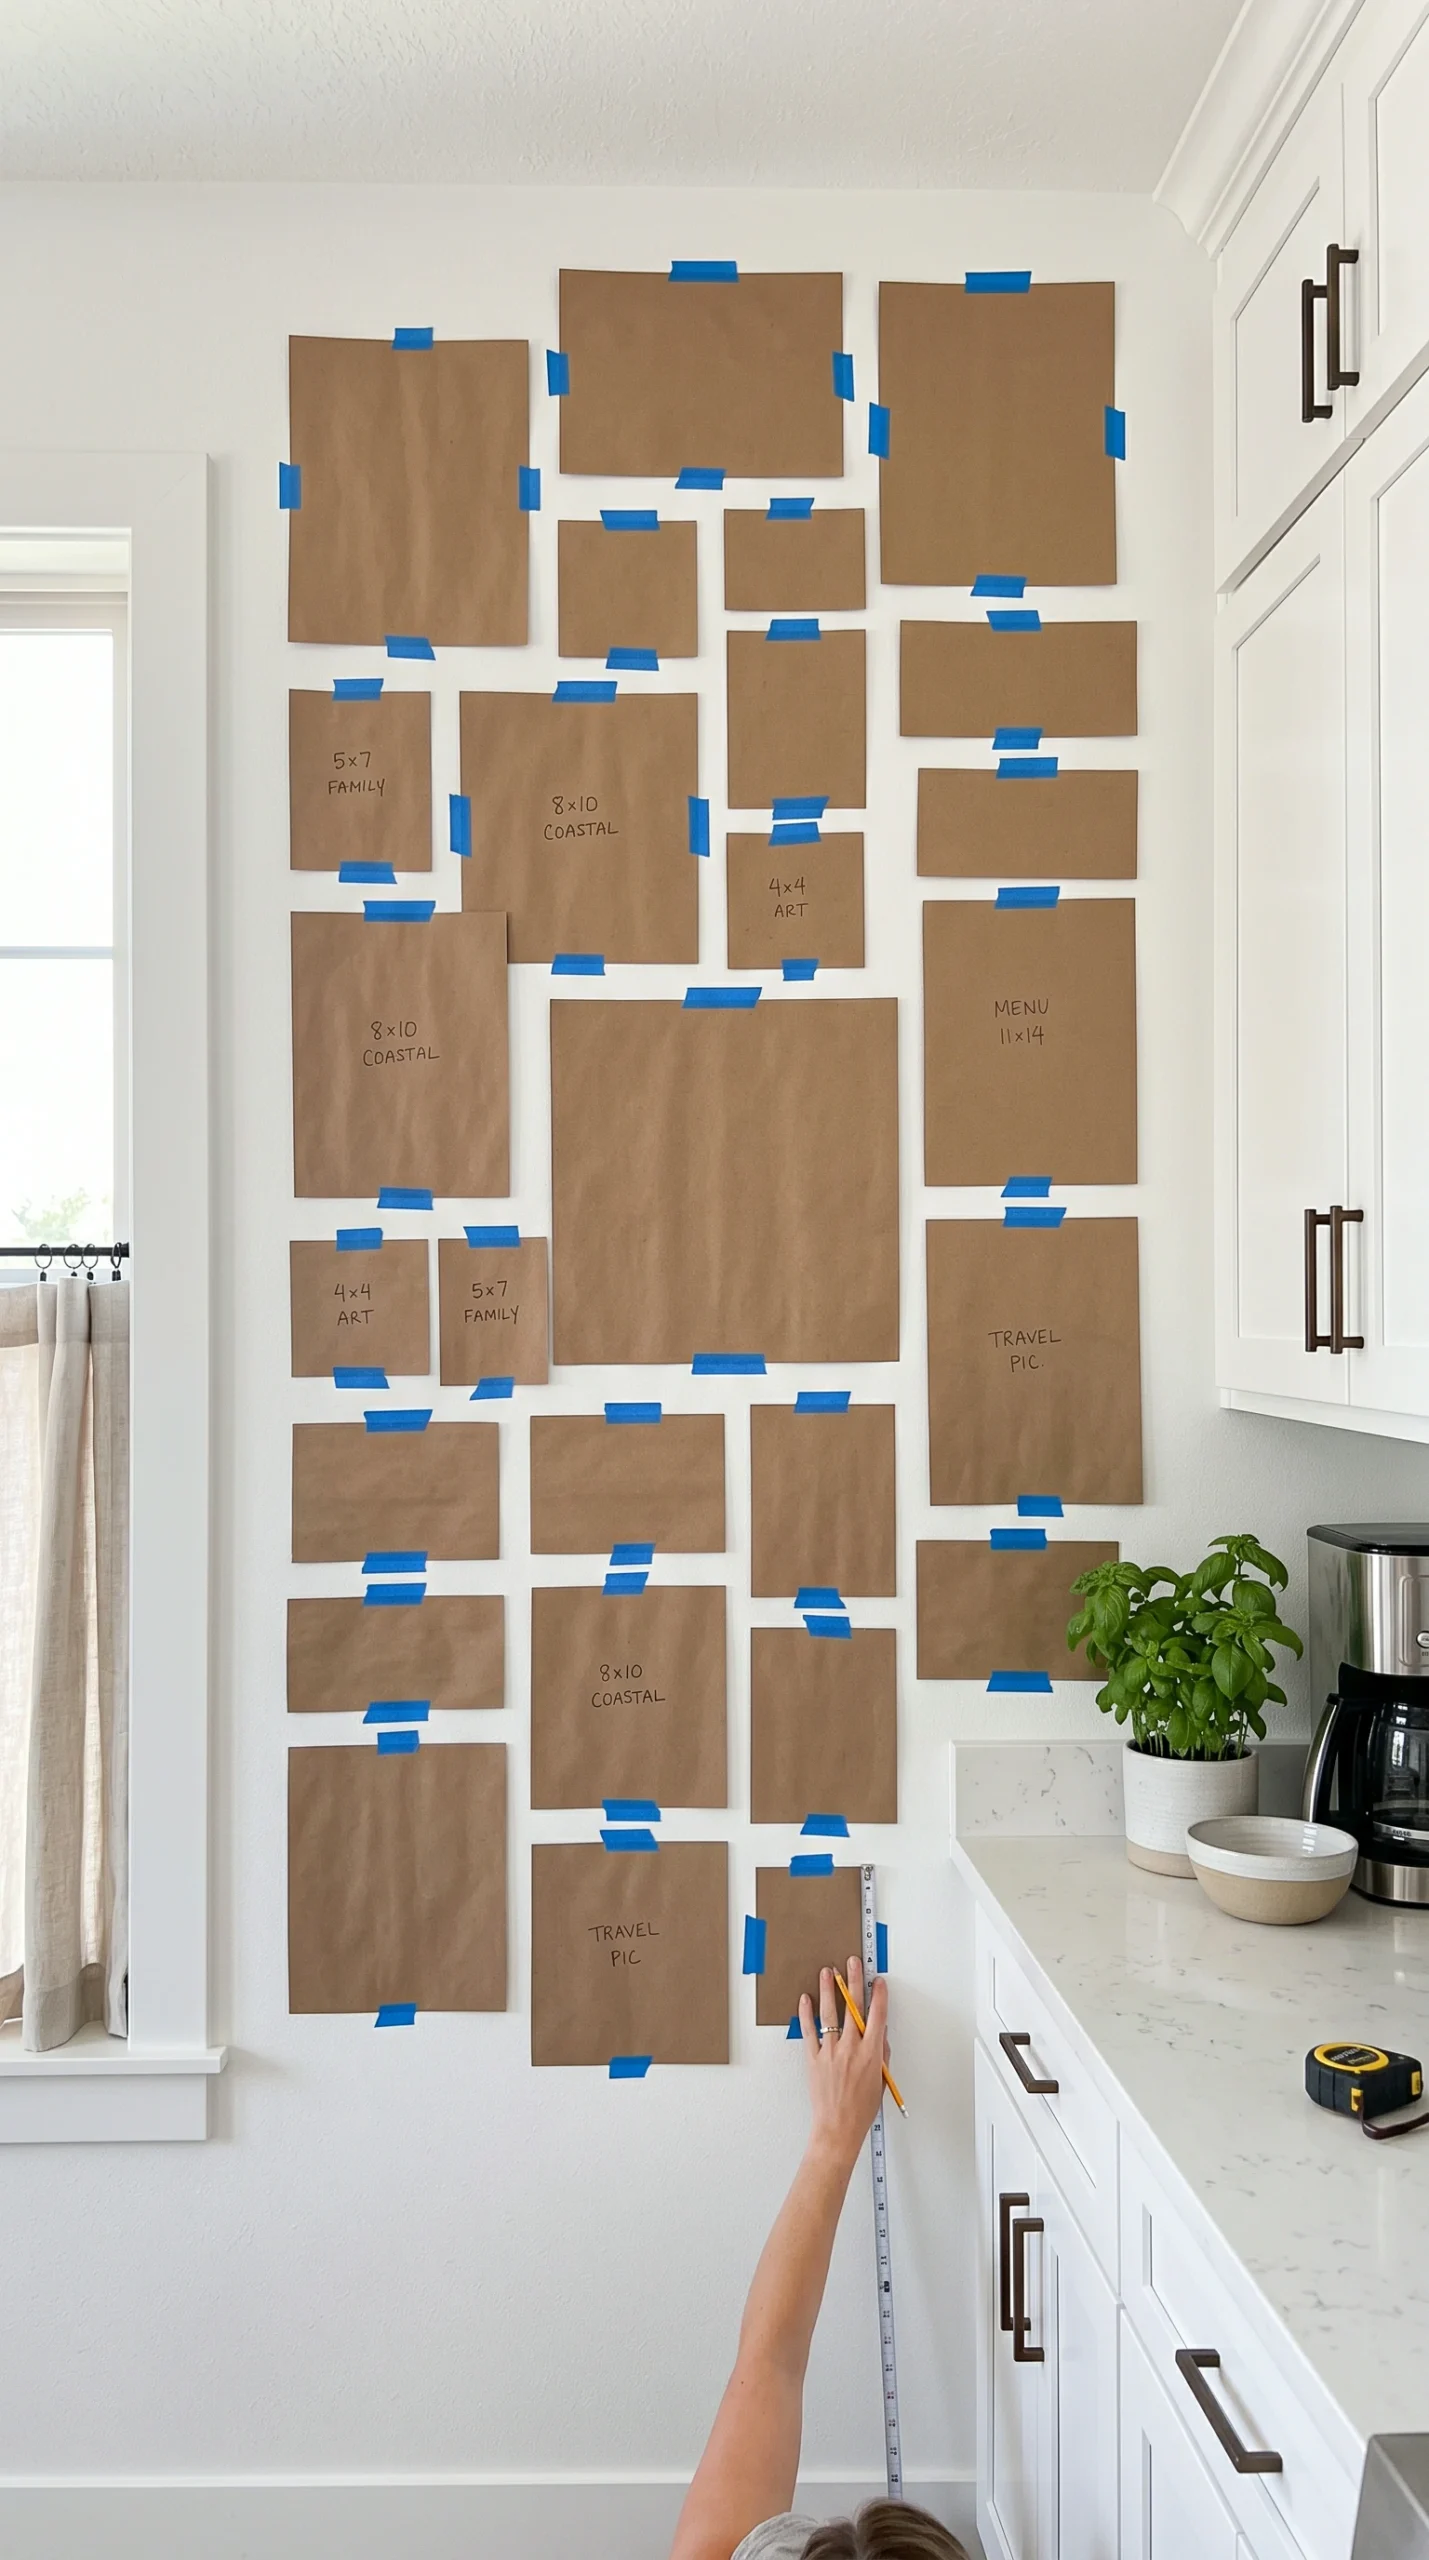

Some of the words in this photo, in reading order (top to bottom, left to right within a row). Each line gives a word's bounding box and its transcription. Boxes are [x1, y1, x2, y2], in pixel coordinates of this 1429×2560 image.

[331, 750, 371, 771] 5x7
[327, 778, 386, 797] FAMILY
[551, 795, 598, 815] 8x10
[543, 821, 620, 841] COASTAL
[768, 876, 807, 898] 4x4
[774, 902, 809, 918] ART
[994, 998, 1049, 1018] MENU
[370, 1019, 418, 1041] 8x10
[1000, 1025, 1045, 1046] 11x14
[362, 1046, 441, 1067] COASTAL
[333, 1282, 372, 1303] 4x4
[471, 1279, 509, 1300] 5x7
[336, 1309, 375, 1327] ART
[464, 1303, 520, 1325] FAMILY
[987, 1328, 1062, 1349] TRAVEL
[599, 1663, 643, 1682] 8x10
[591, 1689, 666, 1708] COASTAL
[587, 1922, 660, 1943] TRAVEL
[610, 1949, 642, 1968] PIC
